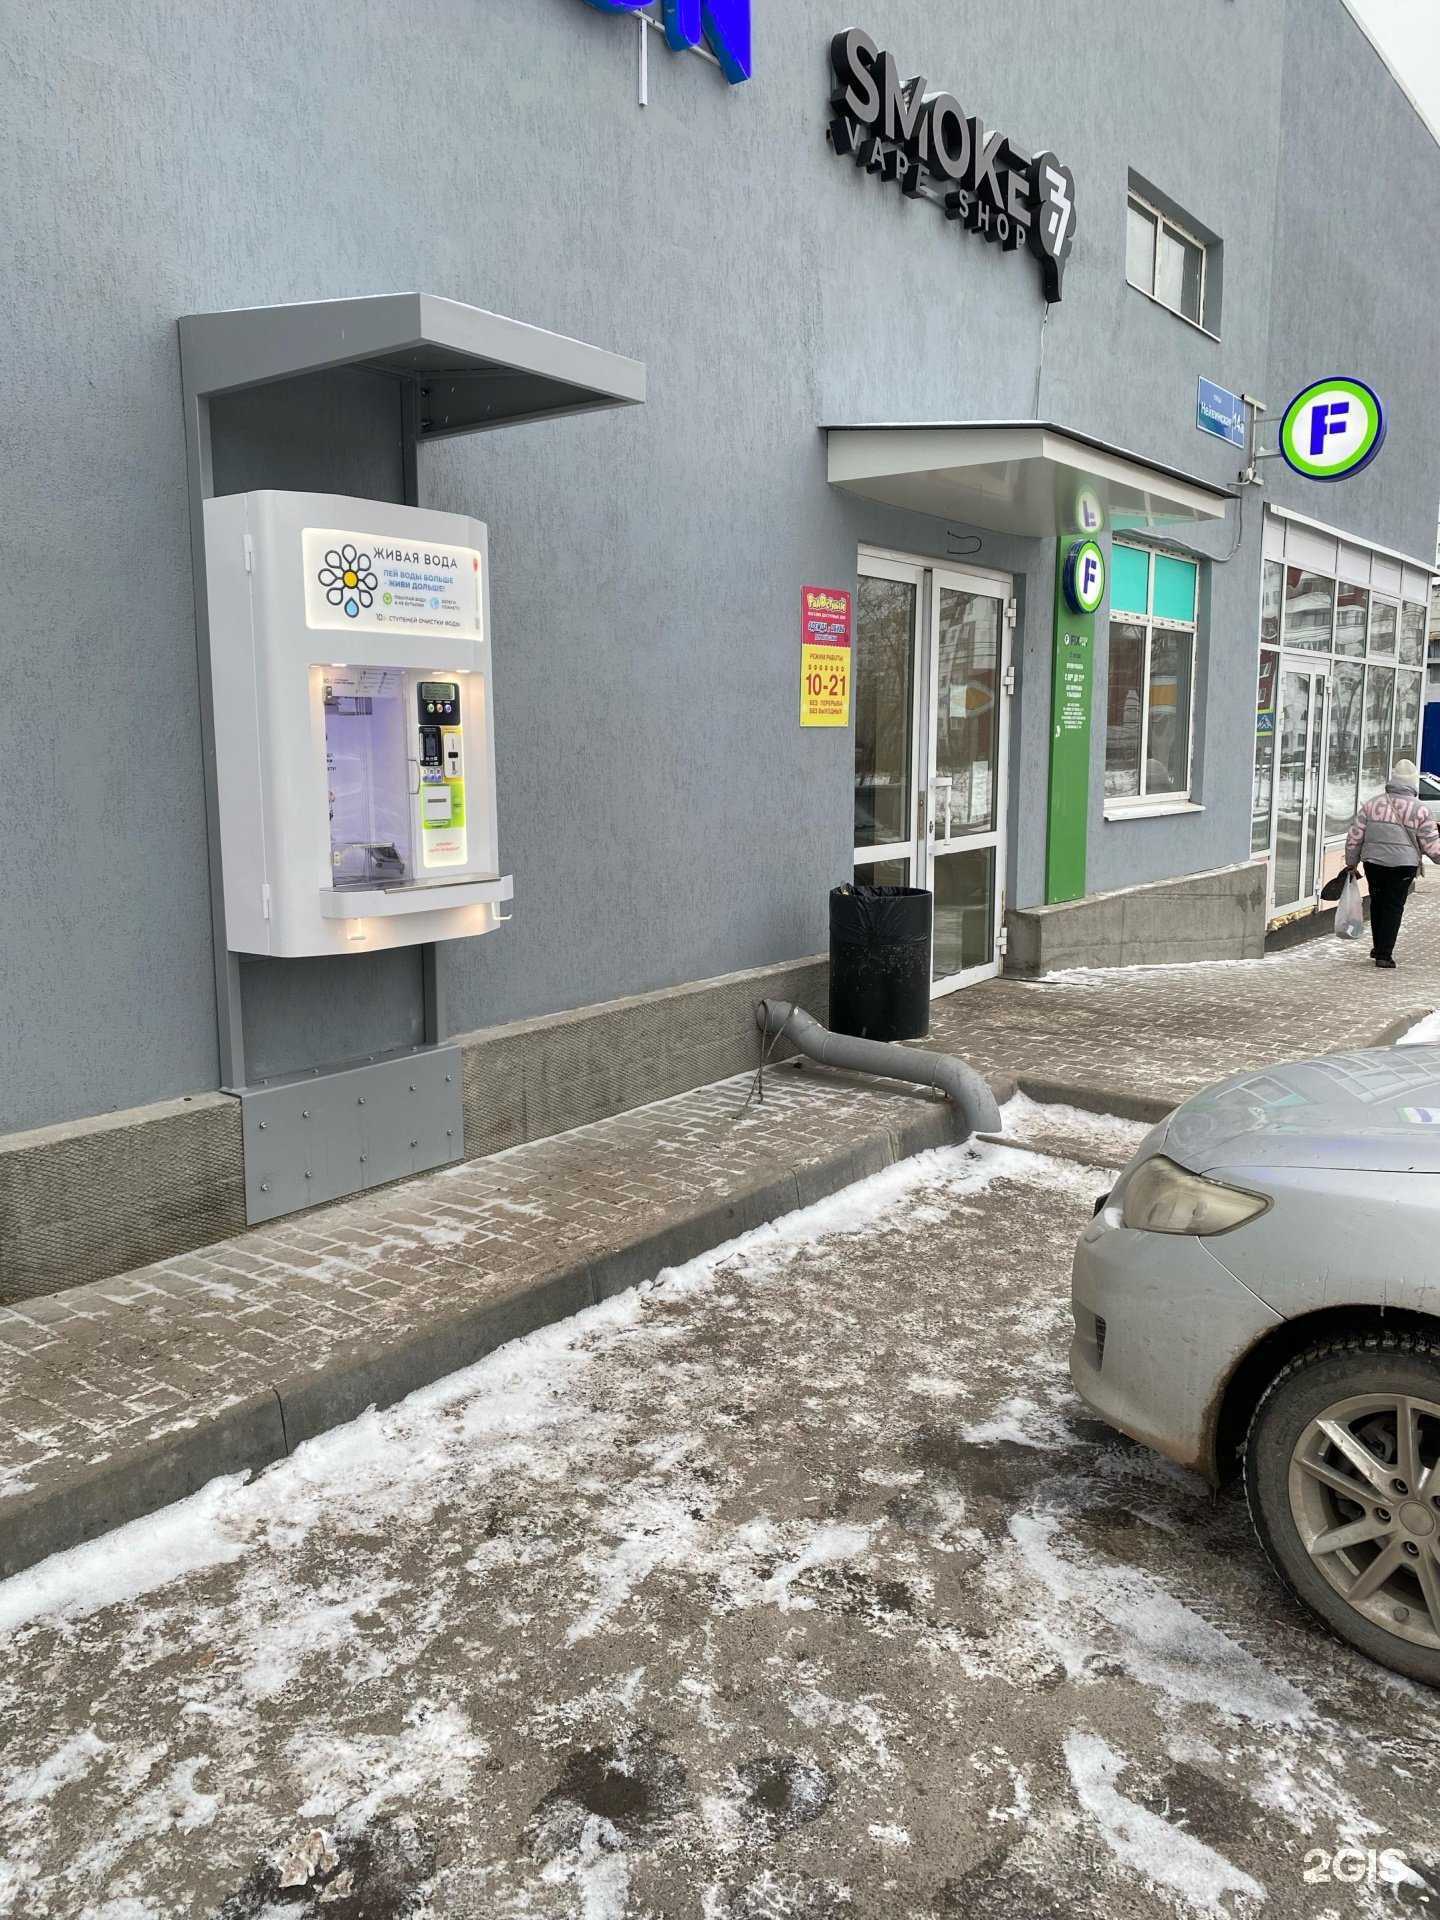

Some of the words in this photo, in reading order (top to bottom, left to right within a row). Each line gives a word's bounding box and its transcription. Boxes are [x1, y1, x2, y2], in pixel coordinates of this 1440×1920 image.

[832, 26, 1032, 226] SMOKE
[834, 116, 931, 198] VAPE
[946, 188, 1027, 250] SHOP
[1309, 401, 1350, 456] F
[373, 546, 419, 564] ЖИВАЯ
[424, 553, 458, 569] ВОДА
[388, 579, 411, 588] ЖИВИ
[400, 571, 422, 581] ВОДЫ
[1083, 557, 1098, 595] F
[805, 673, 846, 697] 10-21
